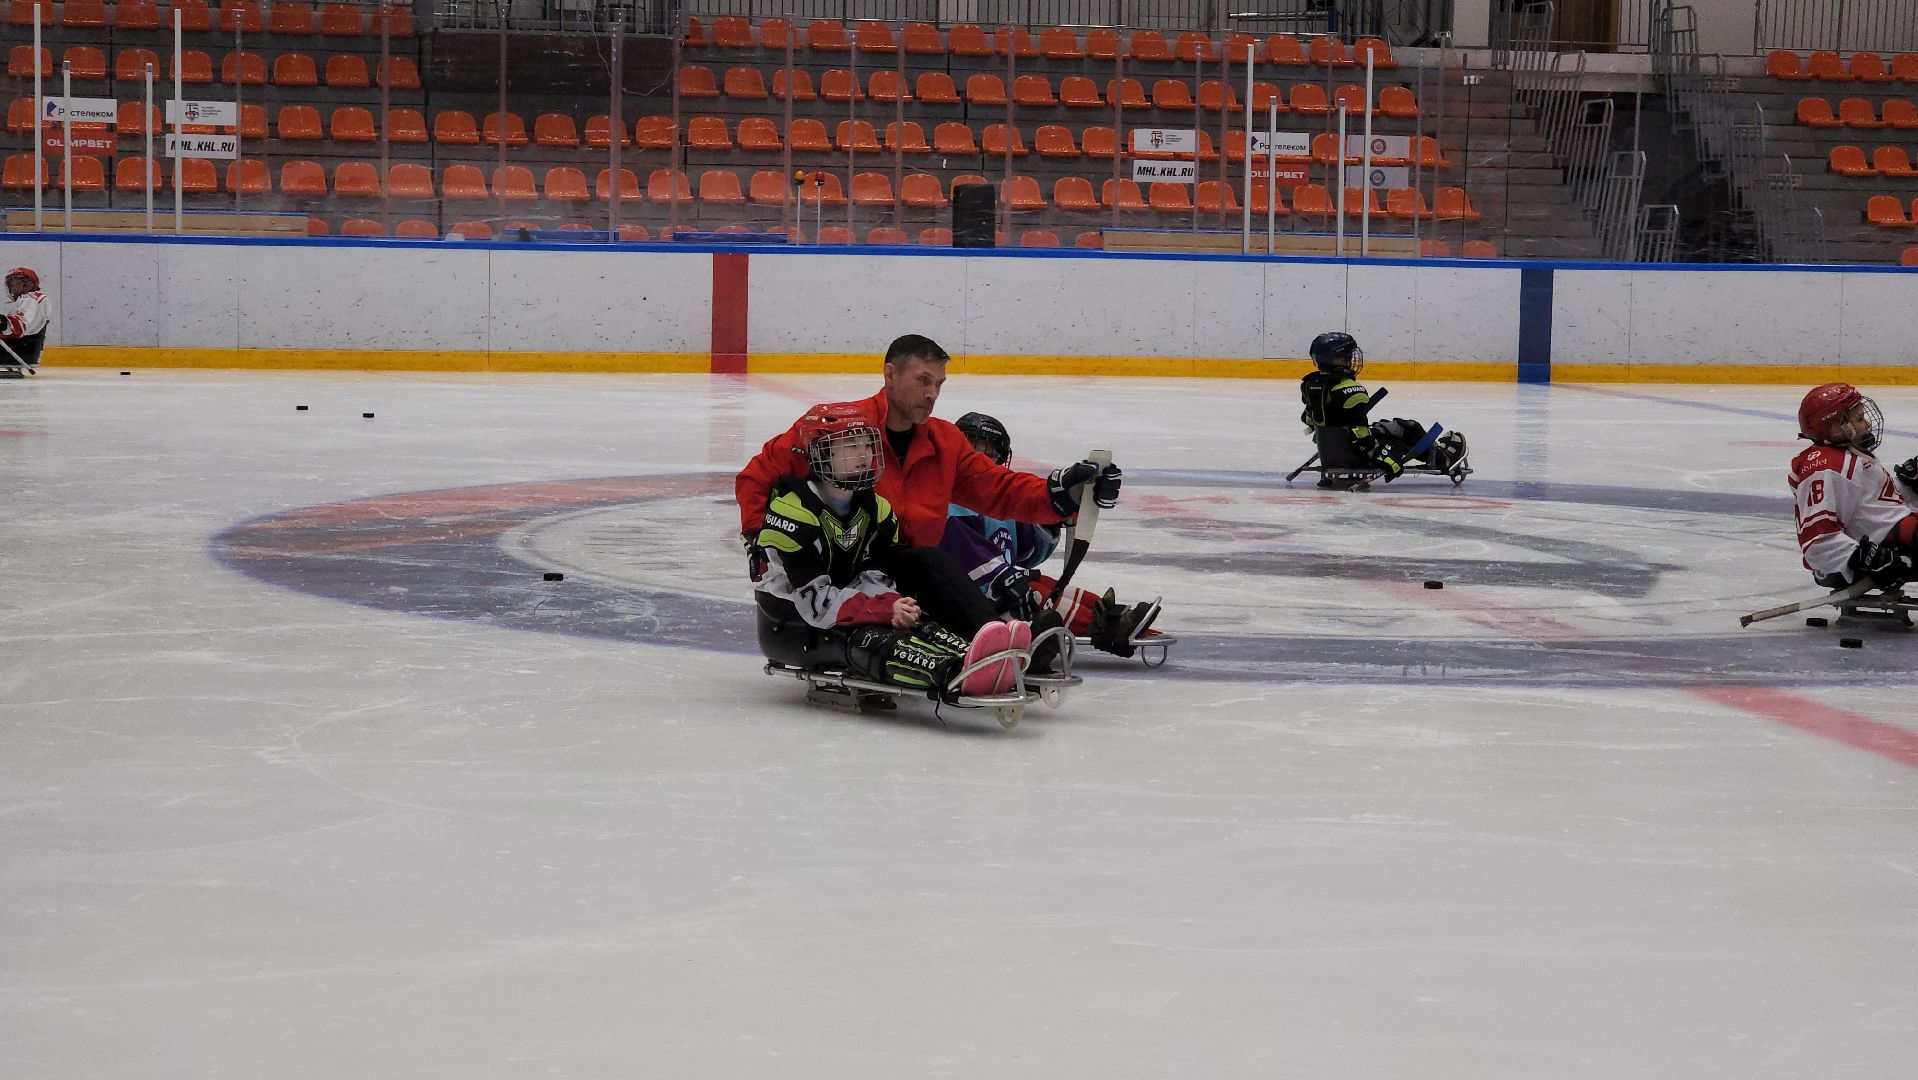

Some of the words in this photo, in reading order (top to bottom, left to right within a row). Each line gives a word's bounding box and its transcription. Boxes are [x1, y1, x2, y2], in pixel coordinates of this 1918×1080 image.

[58, 108, 114, 118] Рстелеком
[46, 138, 113, 149] OLMPBET
[1259, 142, 1306, 151] Ротелеком
[1136, 166, 1194, 177] MHL.KHL.RU
[1807, 479, 1825, 507] 18
[893, 648, 936, 670] YGUARD
